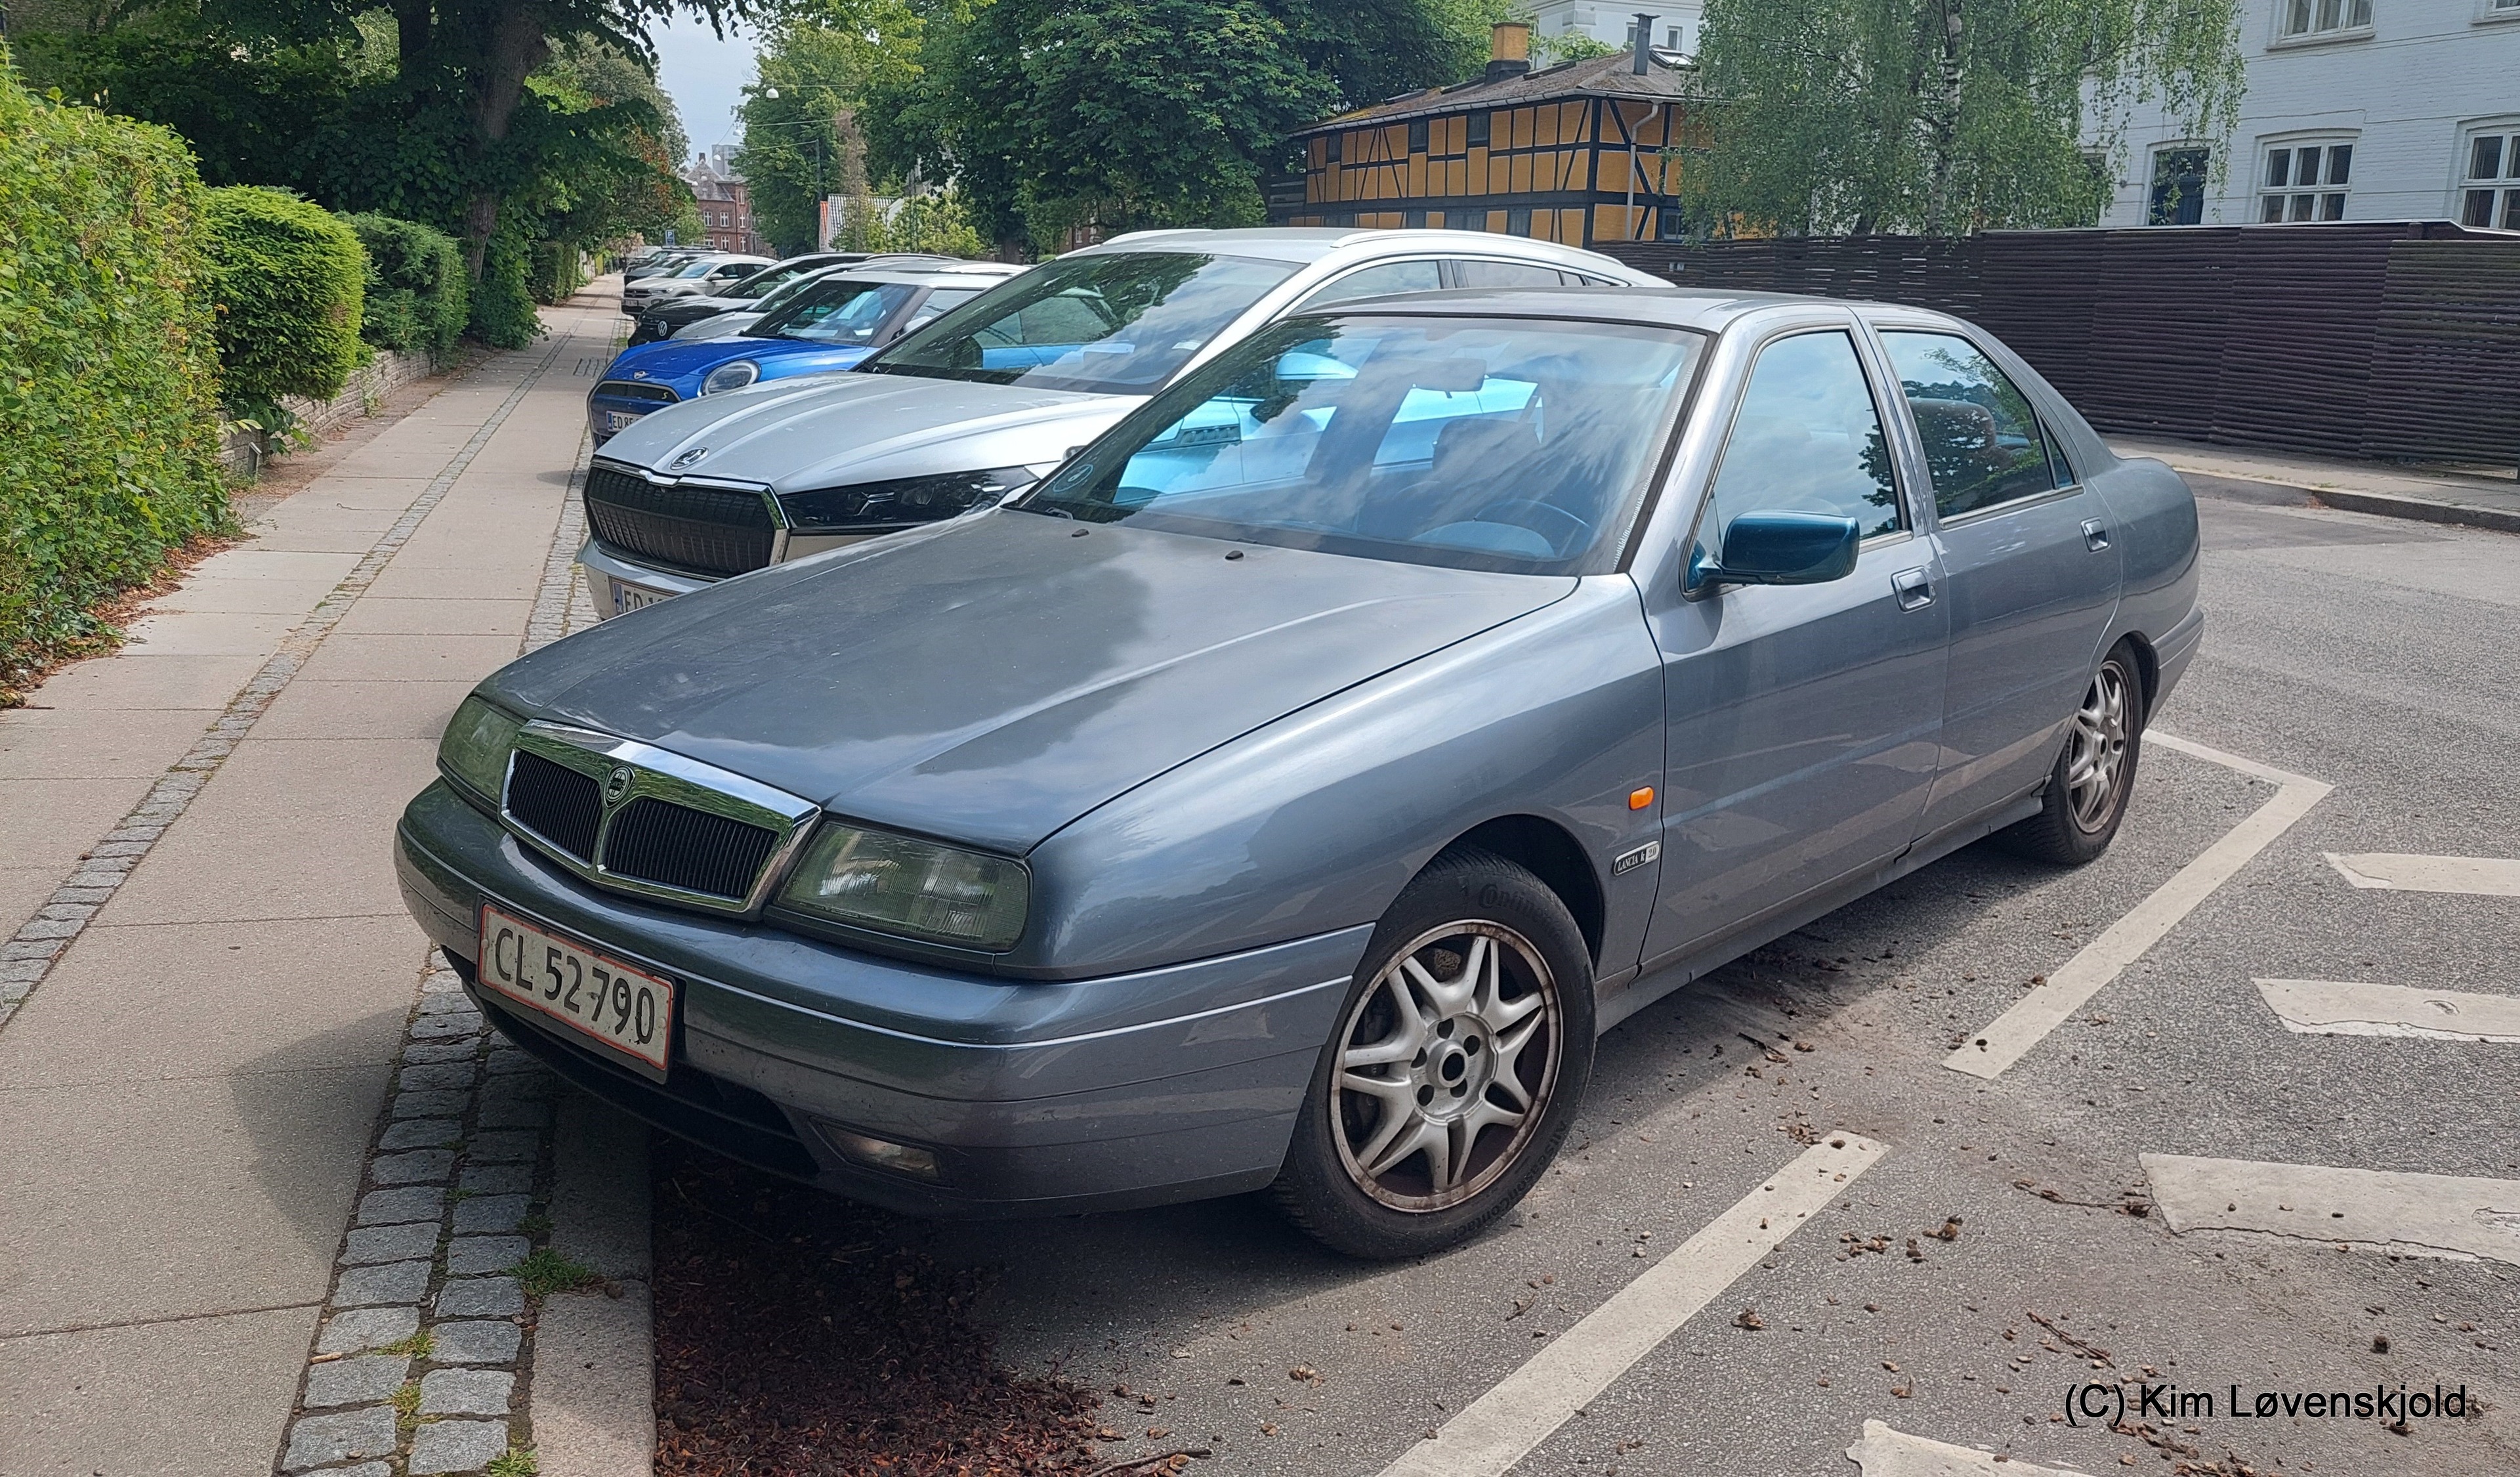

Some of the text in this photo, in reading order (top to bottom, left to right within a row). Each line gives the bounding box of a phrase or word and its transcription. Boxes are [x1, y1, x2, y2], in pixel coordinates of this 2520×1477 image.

[612, 416, 623, 429] ED
[1618, 855, 1639, 872] LANCIA
[495, 928, 534, 991] CL
